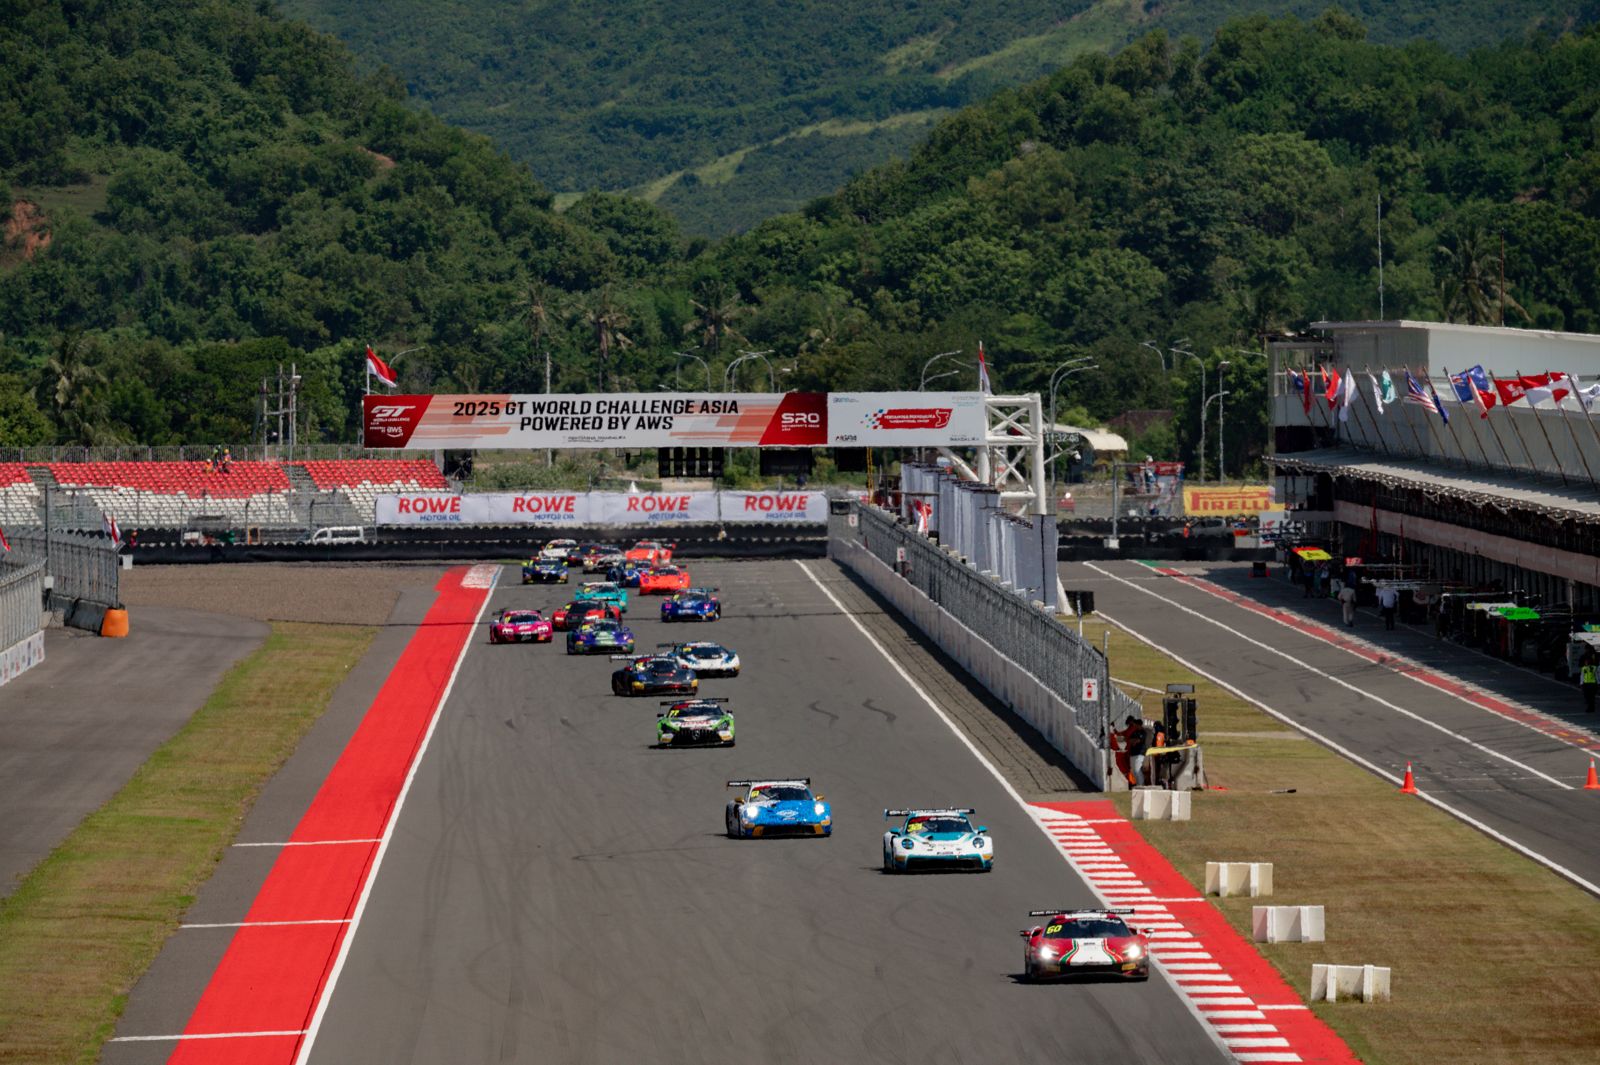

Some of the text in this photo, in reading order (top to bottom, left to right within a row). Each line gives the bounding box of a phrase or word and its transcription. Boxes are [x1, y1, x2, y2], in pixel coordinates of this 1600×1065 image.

[453, 399, 739, 416] 2025 GT WORLD CHALLENGE ASIA
[520, 416, 674, 431] POWERED BY AWS
[781, 412, 820, 424] SRO
[398, 496, 462, 513] ROWE
[512, 496, 576, 513] ROWE
[627, 495, 692, 512] ROWE
[744, 495, 809, 511] ROWE
[1190, 491, 1270, 511] PIRELLI
